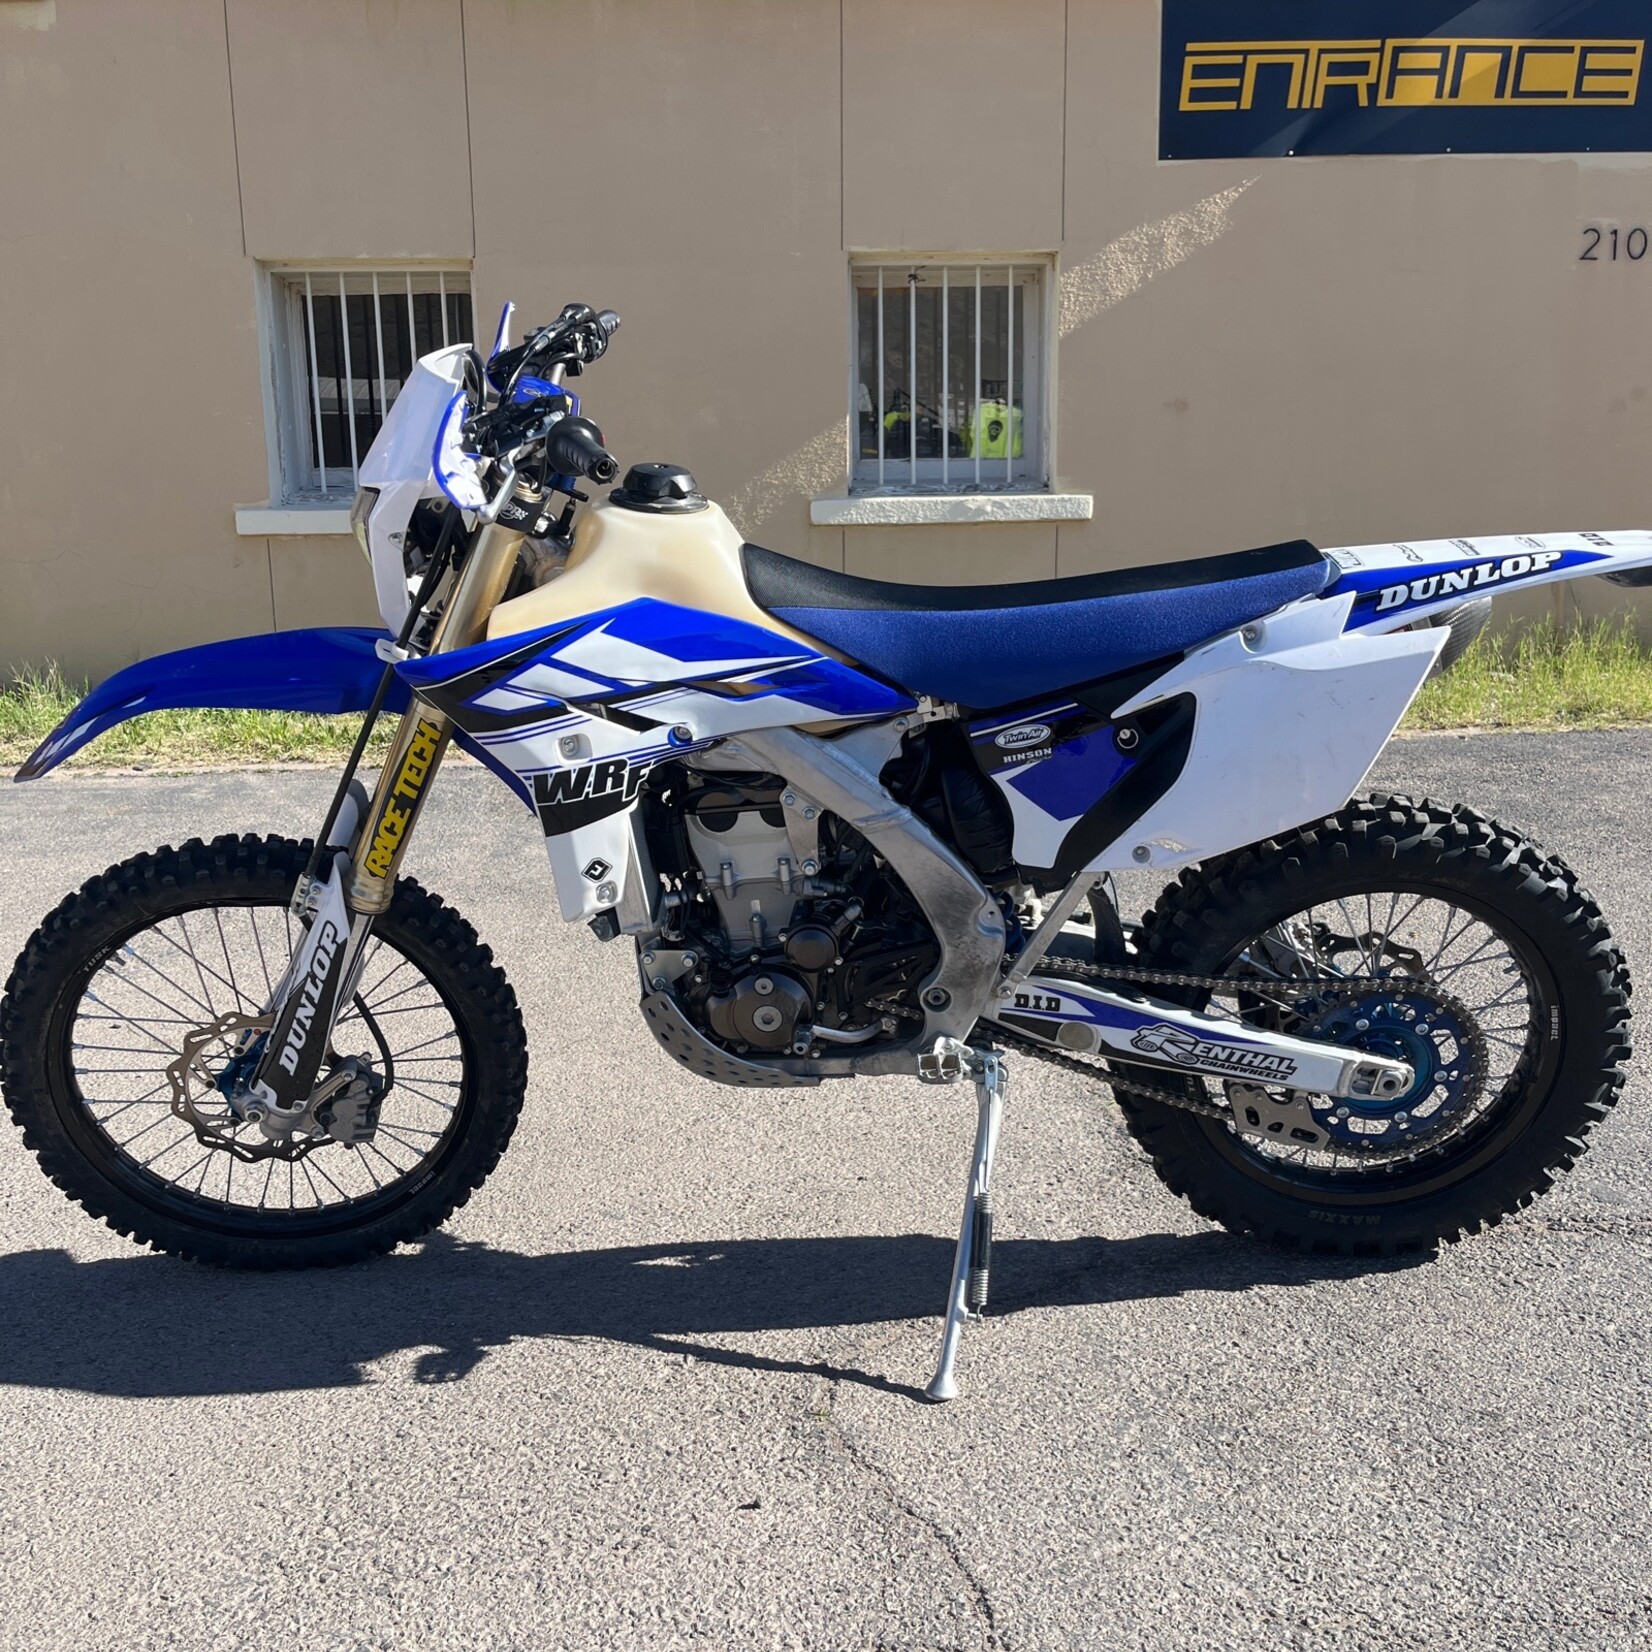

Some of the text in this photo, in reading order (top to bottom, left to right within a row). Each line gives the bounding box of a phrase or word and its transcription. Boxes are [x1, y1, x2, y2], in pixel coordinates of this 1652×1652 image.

[1178, 38, 1645, 111] ENTRANCE
[1579, 227, 1649, 261] 210
[1376, 550, 1562, 611] DUNLOP
[1003, 727, 1044, 745] Twin Air
[1003, 748, 1052, 764] HINSON
[363, 718, 442, 878] RACE TECH
[534, 758, 651, 804] WRF
[82, 945, 112, 973] TUSK
[278, 921, 340, 1076] DUNLOP
[1131, 1023, 1297, 1074] RENTHAL
[1199, 1058, 1290, 1081] CHAINWHEELS
[1308, 1210, 1381, 1225] MAXXIS
